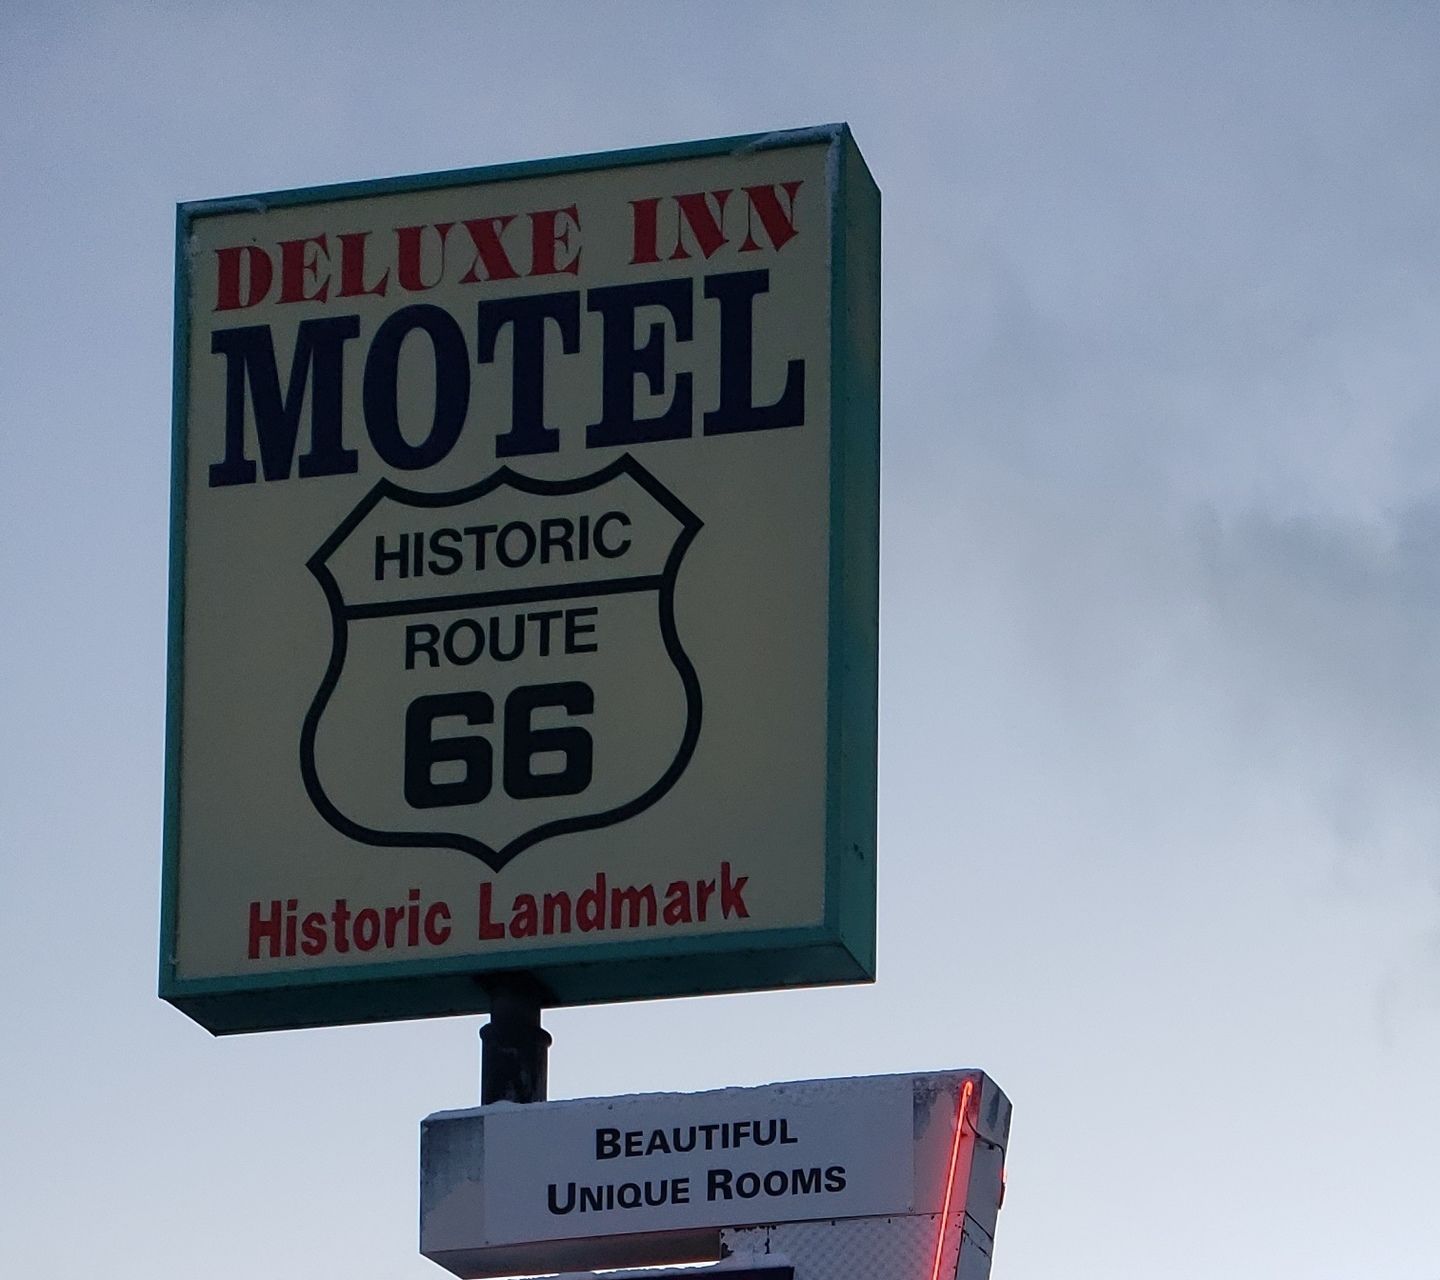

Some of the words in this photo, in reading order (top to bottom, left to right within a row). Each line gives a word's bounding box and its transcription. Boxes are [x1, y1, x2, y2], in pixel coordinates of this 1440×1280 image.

[213, 202, 583, 313] DELUXE
[628, 181, 804, 266] INN
[208, 268, 806, 488] MOTEL
[374, 510, 633, 581] HISTORIC
[404, 606, 599, 670] ROUTE
[403, 680, 595, 810] 66
[248, 888, 452, 962] Historic
[479, 861, 751, 943] Landmark
